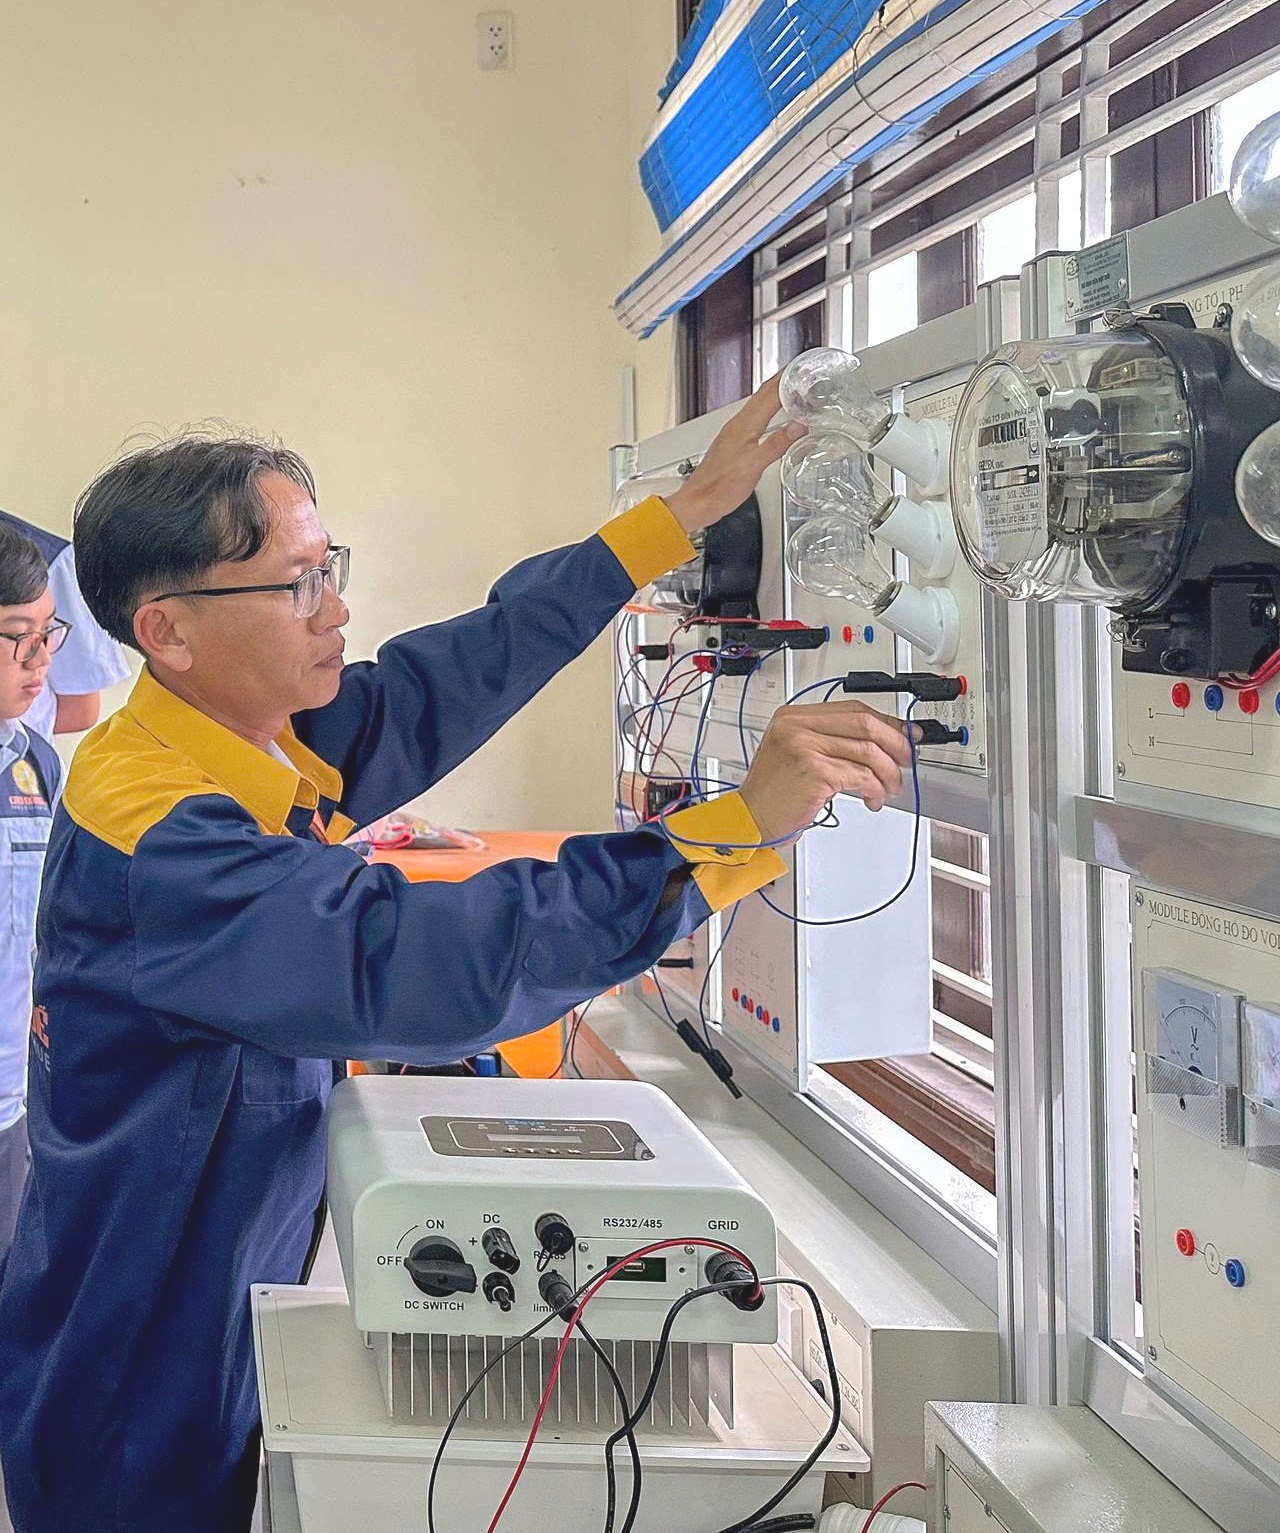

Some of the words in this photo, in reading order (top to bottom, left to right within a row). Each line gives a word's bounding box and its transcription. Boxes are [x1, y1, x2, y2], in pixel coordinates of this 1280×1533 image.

[1148, 899, 1190, 924] MODULE
[425, 1219, 445, 1230] ON
[482, 1213, 501, 1224] DC
[602, 1217, 663, 1230] RS232/485
[707, 1219, 740, 1231] GRID
[376, 1255, 403, 1267] OFF
[404, 1300, 420, 1311] DC
[422, 1301, 465, 1312] SWITCH
